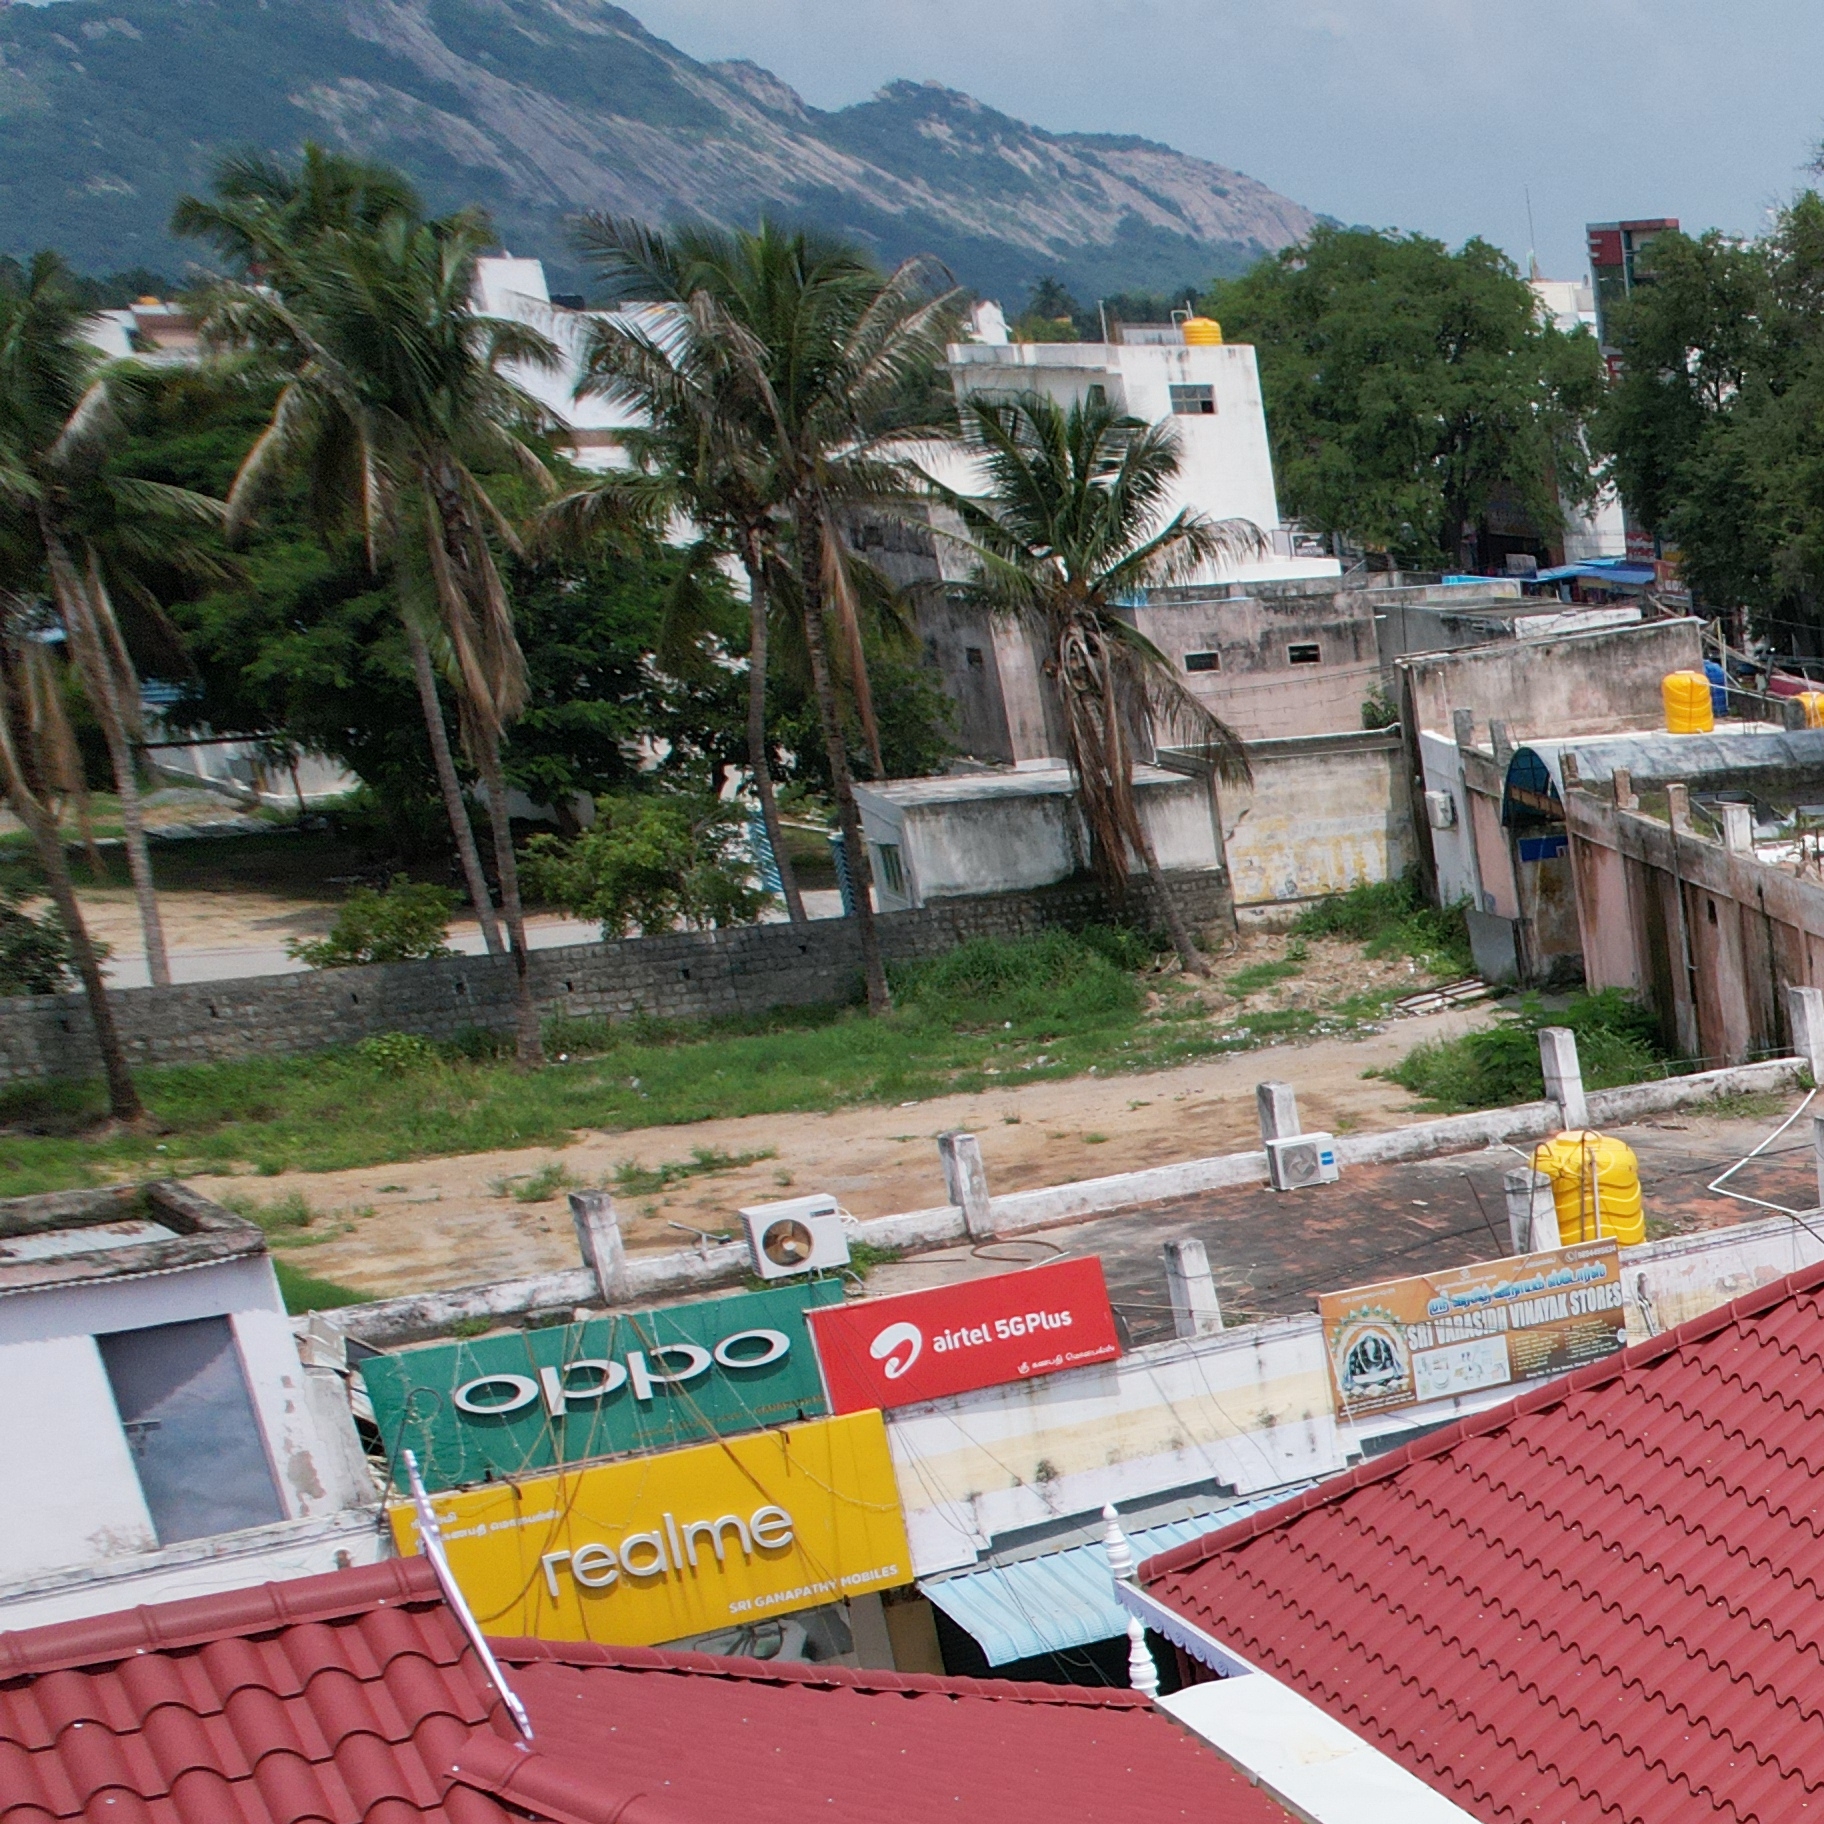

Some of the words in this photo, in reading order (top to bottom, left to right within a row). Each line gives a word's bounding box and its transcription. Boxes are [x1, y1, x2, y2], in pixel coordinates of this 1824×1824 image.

[932, 1323, 993, 1353] airtel
[1406, 1320, 1433, 1351] SRI
[1509, 1292, 1569, 1329] VINAYAK
[1569, 1280, 1623, 1317] STORES
[453, 1328, 792, 1417] oppo
[541, 1504, 794, 1598] realme
[728, 1602, 752, 1615] SRI
[754, 1578, 837, 1608] GANAPATHY
[841, 1564, 898, 1588] MOBILES
